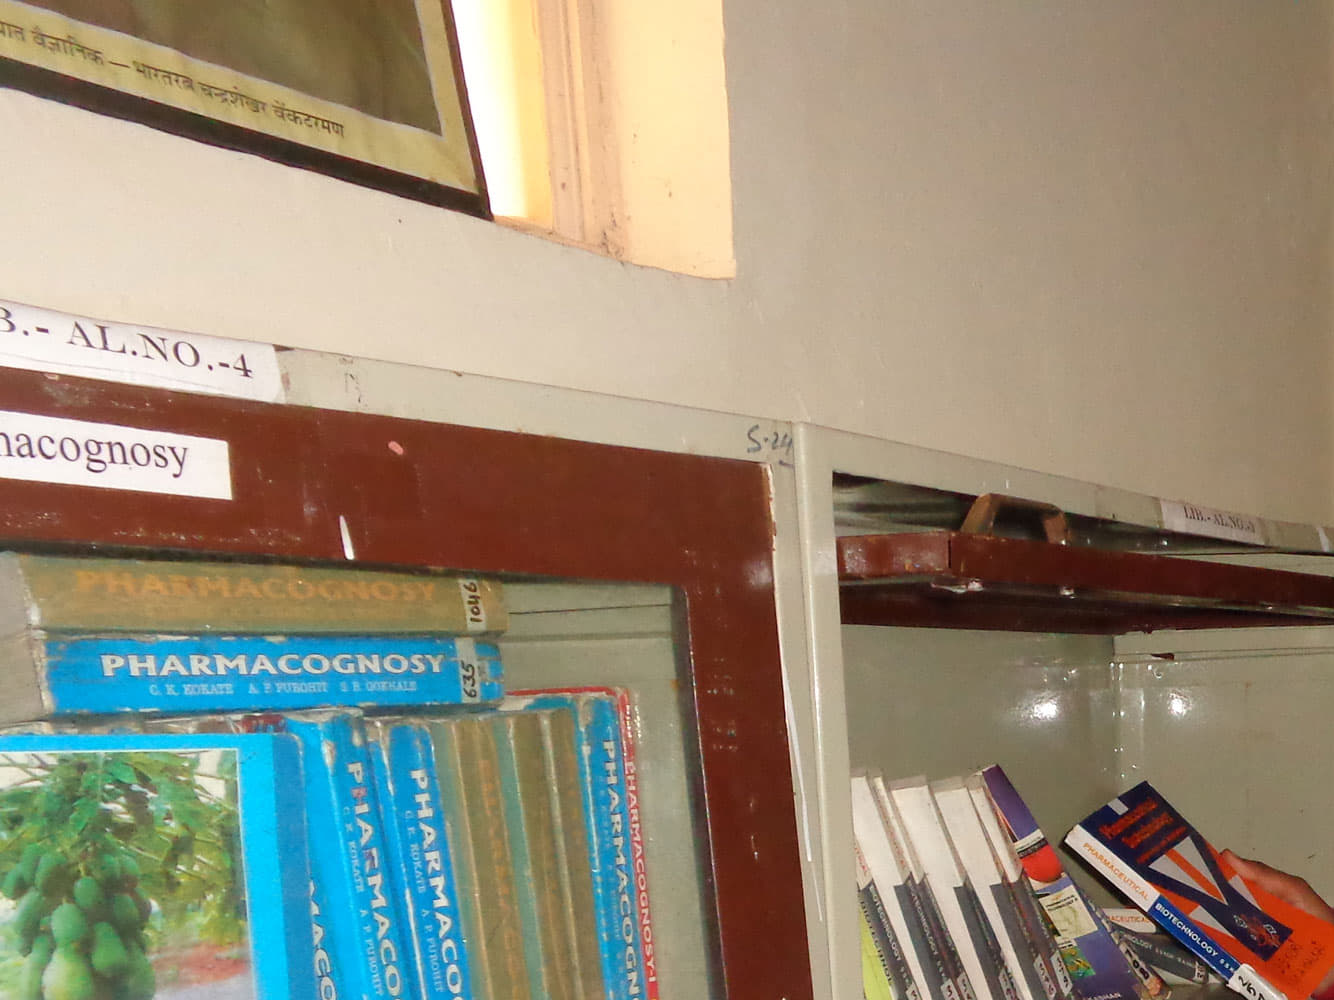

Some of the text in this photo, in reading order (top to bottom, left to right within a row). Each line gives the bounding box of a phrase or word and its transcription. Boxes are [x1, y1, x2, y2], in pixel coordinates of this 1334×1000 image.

[76, 569, 435, 601] PHARMACOGNOSY
[100, 652, 445, 678] PHARMACOGNOSY
[1083, 842, 1149, 901] PHARMACEUTICAL
[1155, 903, 1218, 958] BIOTECHNOLOGY
